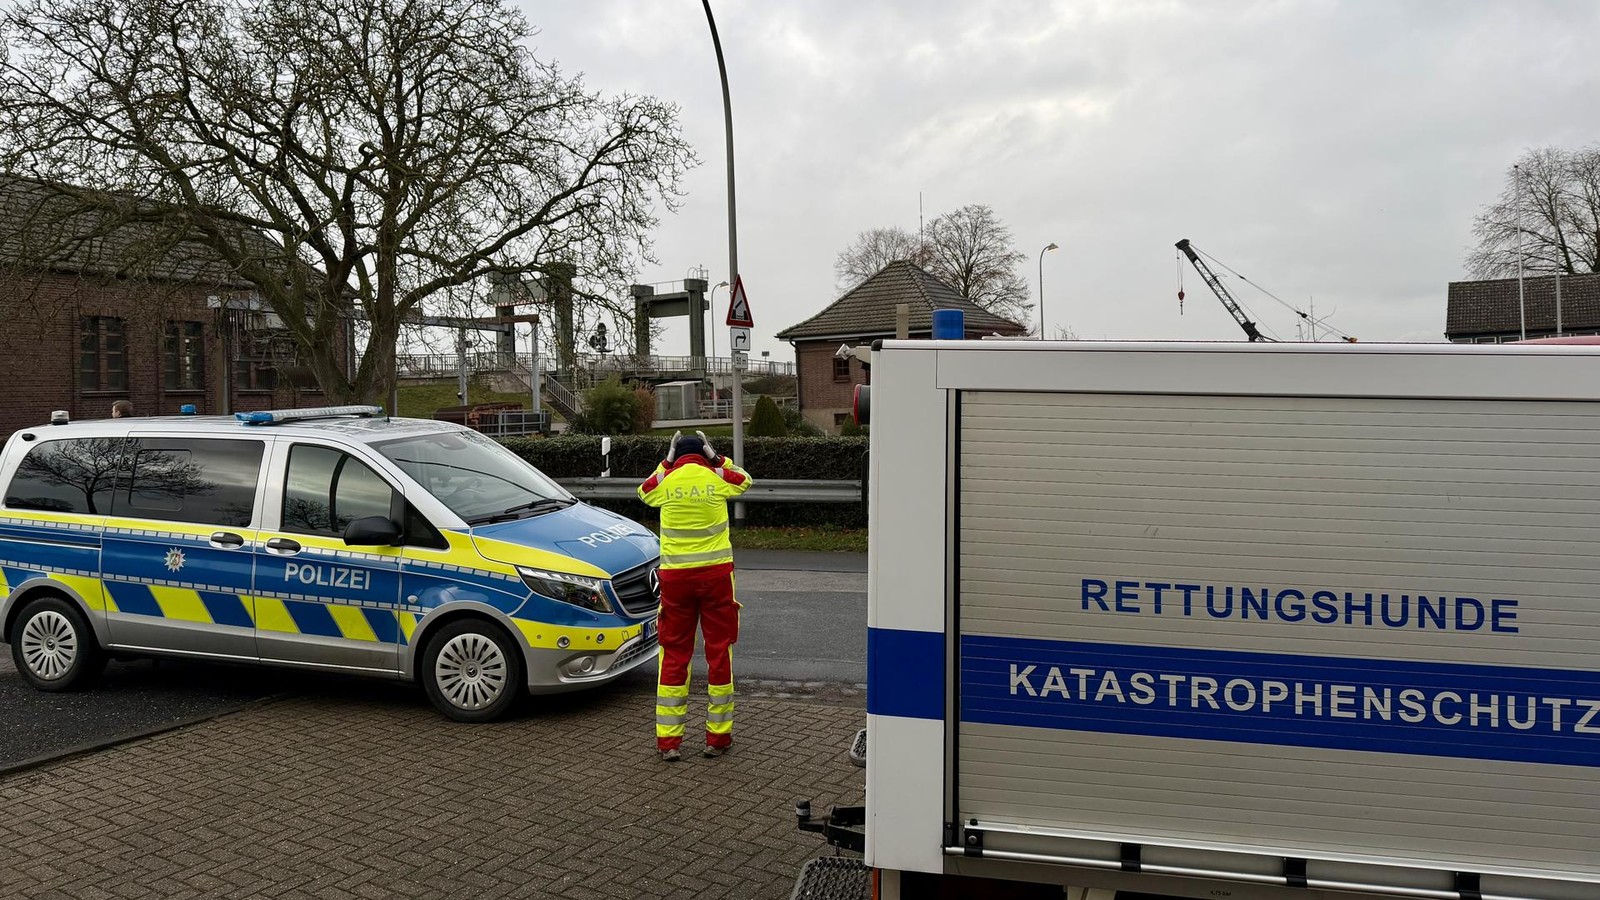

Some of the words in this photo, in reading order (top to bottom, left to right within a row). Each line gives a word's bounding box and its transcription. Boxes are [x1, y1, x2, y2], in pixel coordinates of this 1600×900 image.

[577, 523, 636, 548] POLIZEI
[284, 562, 370, 590] POLIZEI
[1081, 578, 1519, 633] RETTUNGSHUNDE
[1009, 663, 1600, 733] KATASTROPHENSCHUTZ
